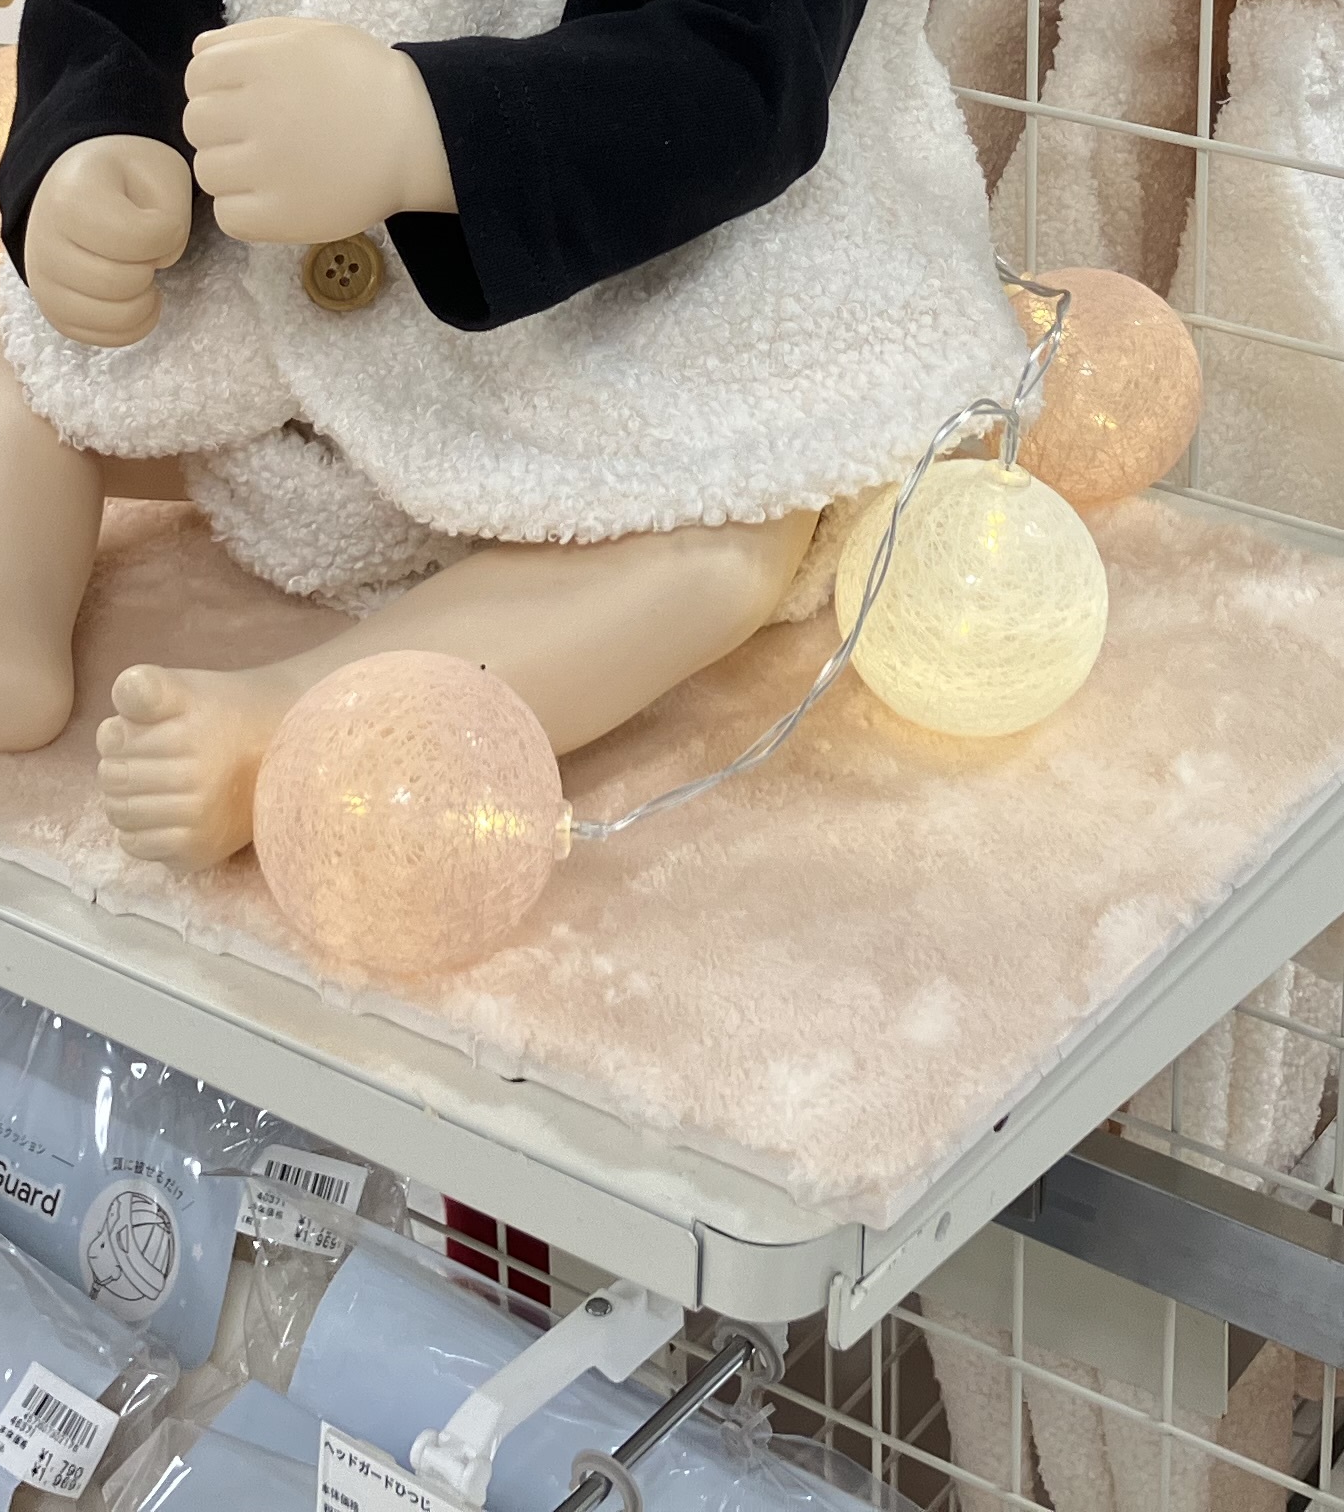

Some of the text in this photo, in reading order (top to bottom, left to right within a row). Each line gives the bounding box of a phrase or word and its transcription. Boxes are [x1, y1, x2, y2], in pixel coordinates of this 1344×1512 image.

[324, 1440, 431, 1512] ヘッドガードひつじ
